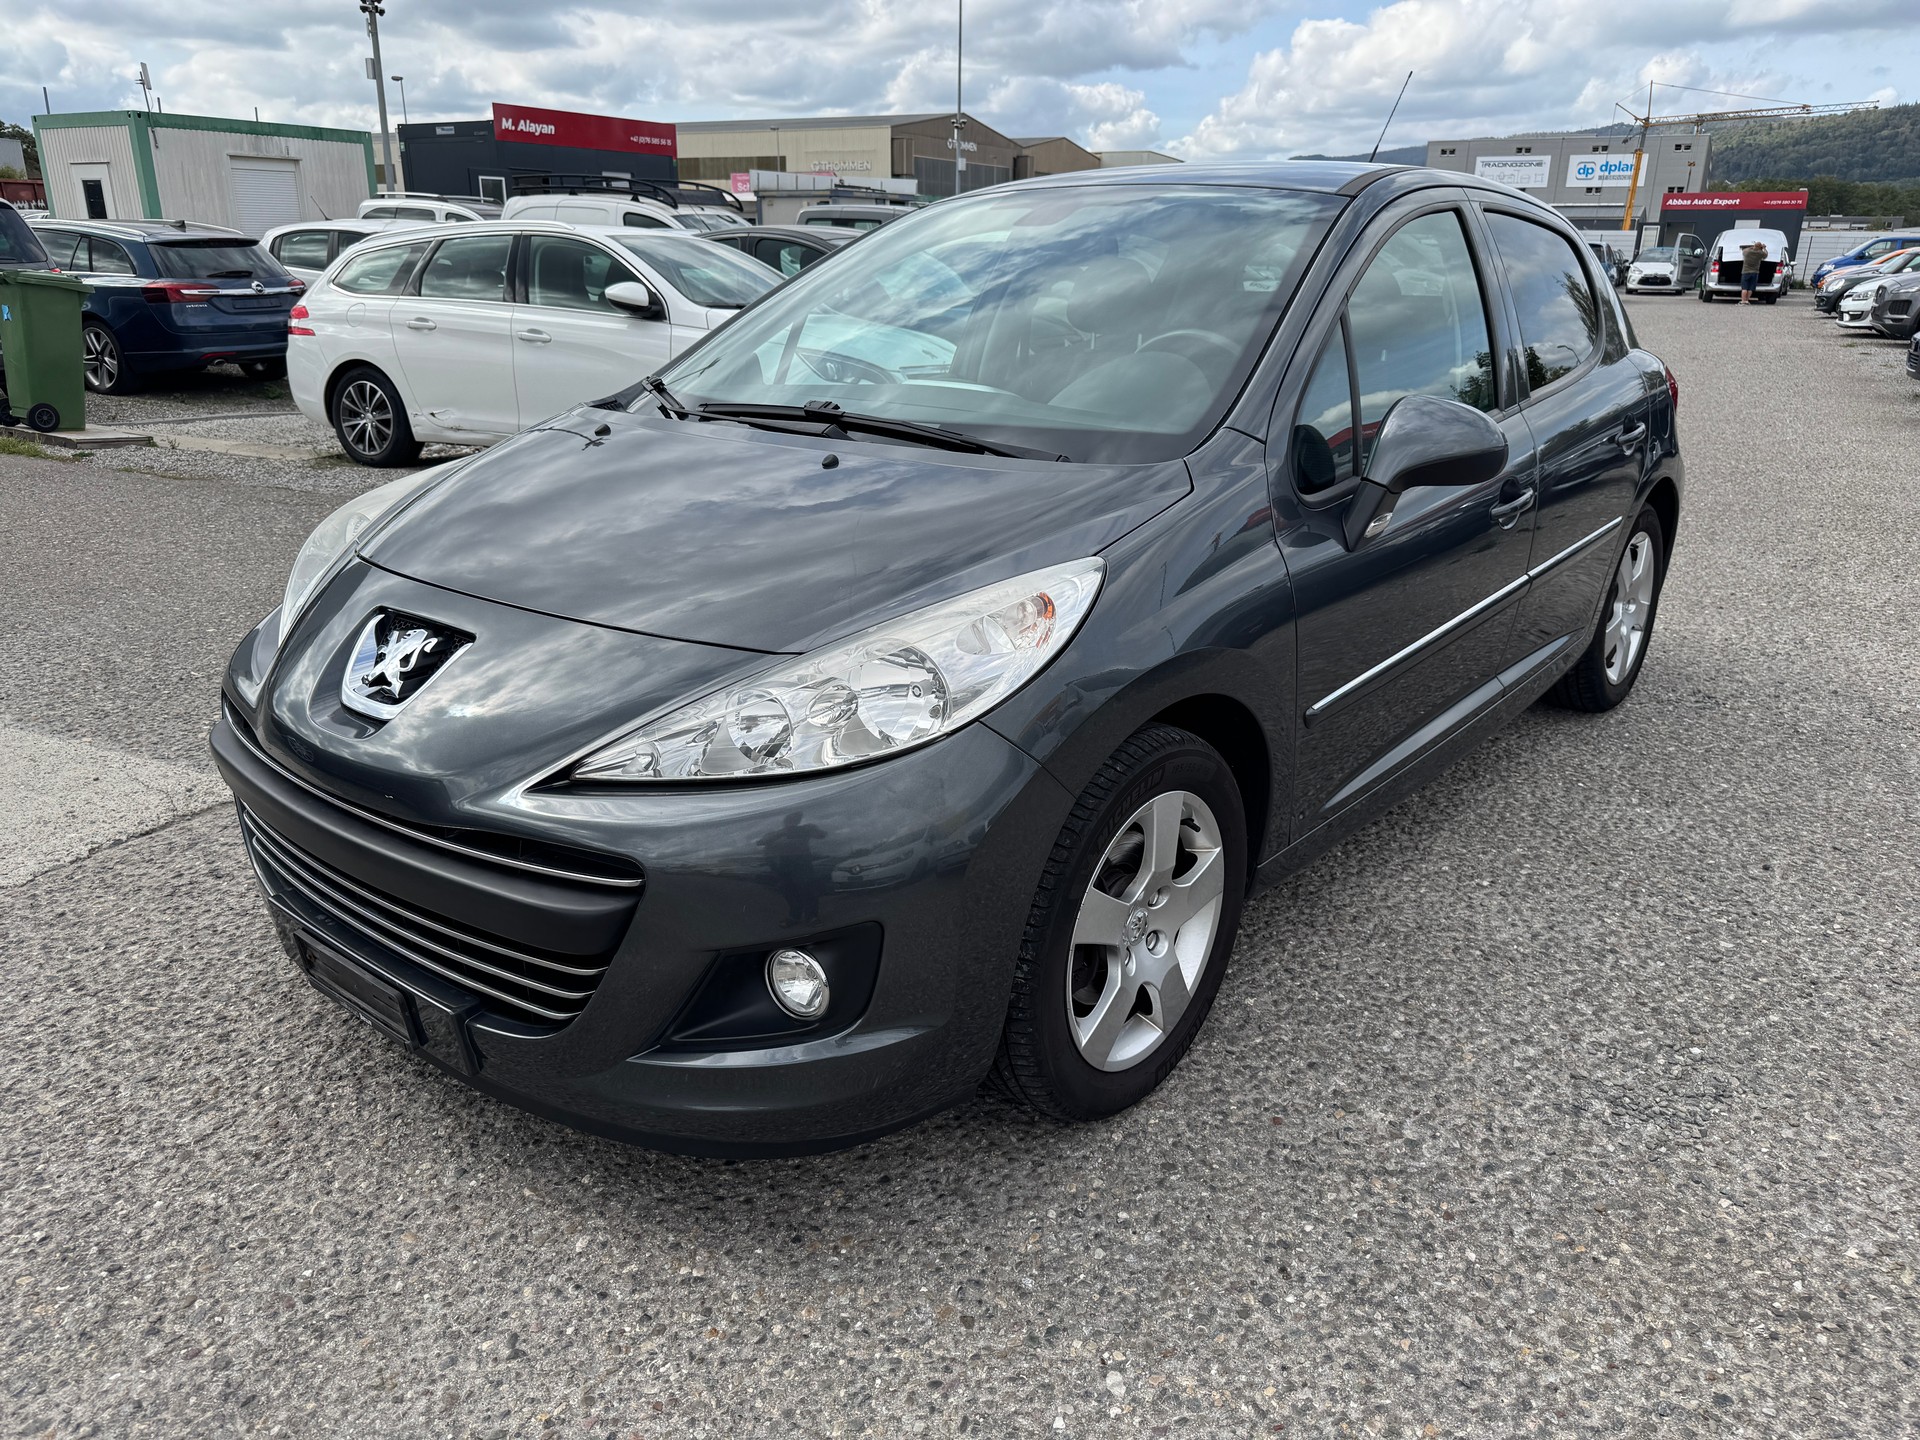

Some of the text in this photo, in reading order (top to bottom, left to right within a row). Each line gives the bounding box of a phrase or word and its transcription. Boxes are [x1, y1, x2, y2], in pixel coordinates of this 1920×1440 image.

[502, 117, 555, 136] M. Alayan
[820, 161, 871, 171] THOMMEN
[1577, 164, 1595, 177] dp
[1713, 198, 1740, 206] Export
[1096, 767, 1163, 850] MICHELIN
